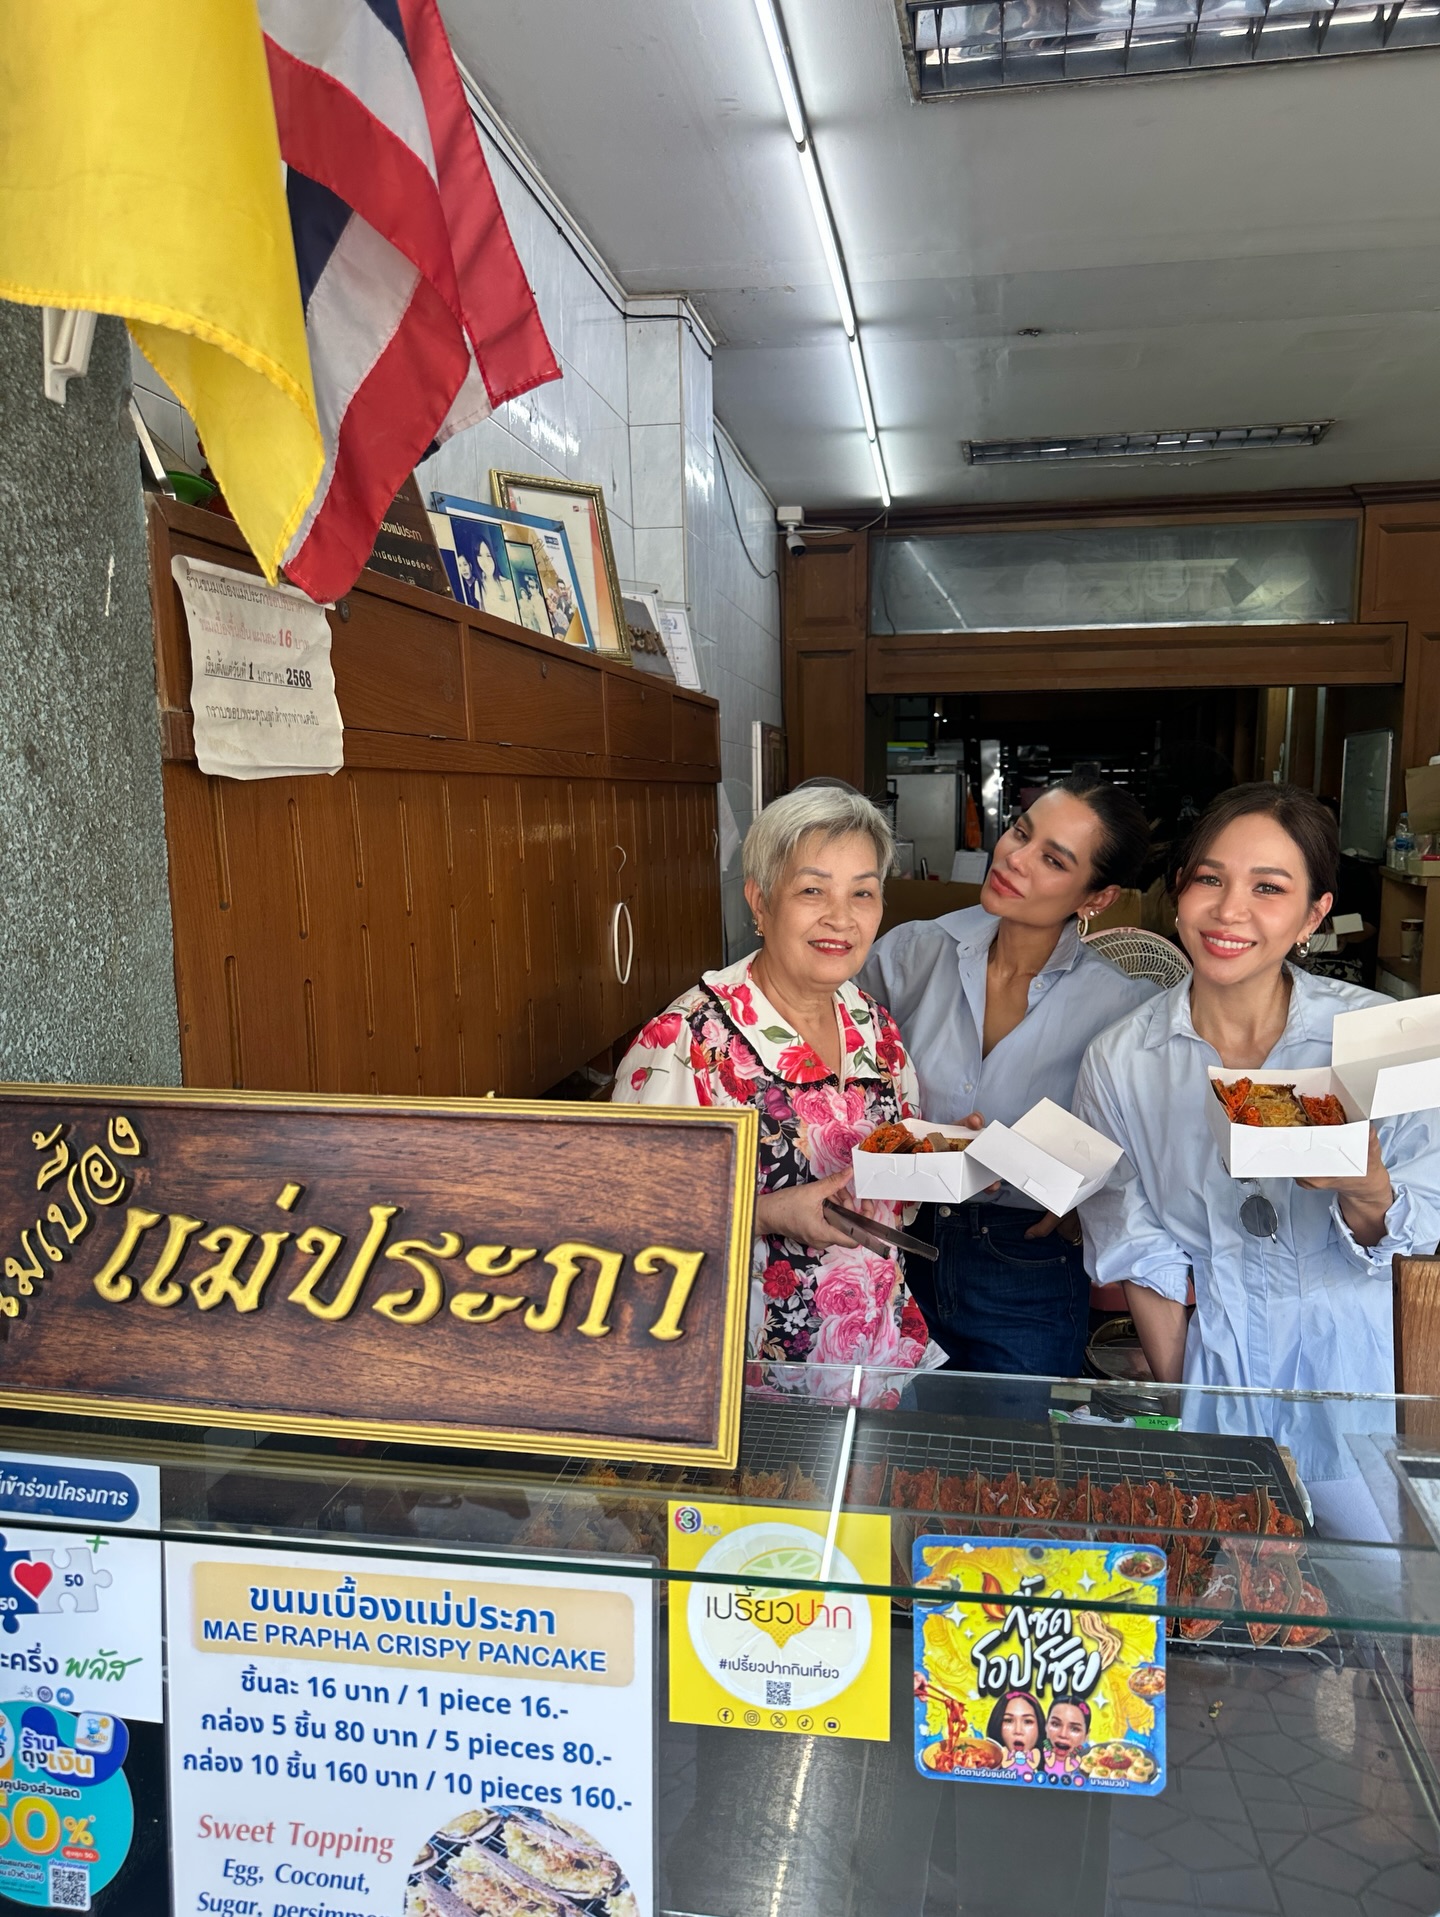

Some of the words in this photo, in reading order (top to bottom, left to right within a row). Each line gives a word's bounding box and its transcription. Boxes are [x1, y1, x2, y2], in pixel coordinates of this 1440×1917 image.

[278, 628, 292, 649] 16
[249, 661, 254, 680] 1
[286, 667, 312, 688] 2568
[93, 1181, 705, 1342] แม่ประภา
[64, 1573, 84, 1587] 50
[249, 1575, 556, 1635] ขนมเบื้องแม่ประภา
[706, 1585, 852, 1630] เปรี้ยวปาก
[65, 1648, 144, 1682] พลัส
[203, 1619, 258, 1642] MAE
[265, 1623, 371, 1652] PRAPHA
[377, 1633, 471, 1661] CRISPY
[478, 1641, 607, 1673] PANCAKE
[718, 1654, 840, 1680] #เปรี้ยวปากกินเที่ยว
[241, 1663, 300, 1695] ชิ้นละ
[307, 1676, 337, 1699] 16
[345, 1683, 390, 1704] บาท
[398, 1684, 408, 1705] /
[417, 1686, 429, 1707] 1
[440, 1688, 512, 1716] piece
[520, 1695, 569, 1719] 16.-
[22, 1731, 55, 1752] ร้าน
[201, 1706, 265, 1734] กล่อง
[272, 1714, 287, 1736] 5
[295, 1710, 327, 1739] ชิ้น
[334, 1720, 365, 1743] 80
[373, 1728, 418, 1749] บาท
[426, 1729, 437, 1749] /
[445, 1730, 460, 1752] 5
[469, 1733, 555, 1760] pieces
[562, 1741, 612, 1766] 80.-
[21, 1748, 93, 1776] ถุงเงิน
[183, 1747, 243, 1774] กล่อง
[251, 1754, 279, 1776] 10
[286, 1751, 316, 1780] ชิ้น
[325, 1760, 368, 1785] 160
[376, 1769, 418, 1789] บาท
[425, 1770, 436, 1791] /
[444, 1772, 473, 1795] 10
[481, 1775, 562, 1803] pieces
[571, 1785, 632, 1811] 160.-
[197, 1814, 276, 1844] Sweet
[289, 1821, 395, 1864] Topping
[223, 1858, 264, 1887] Egg,
[275, 1863, 371, 1894] Coconut,
